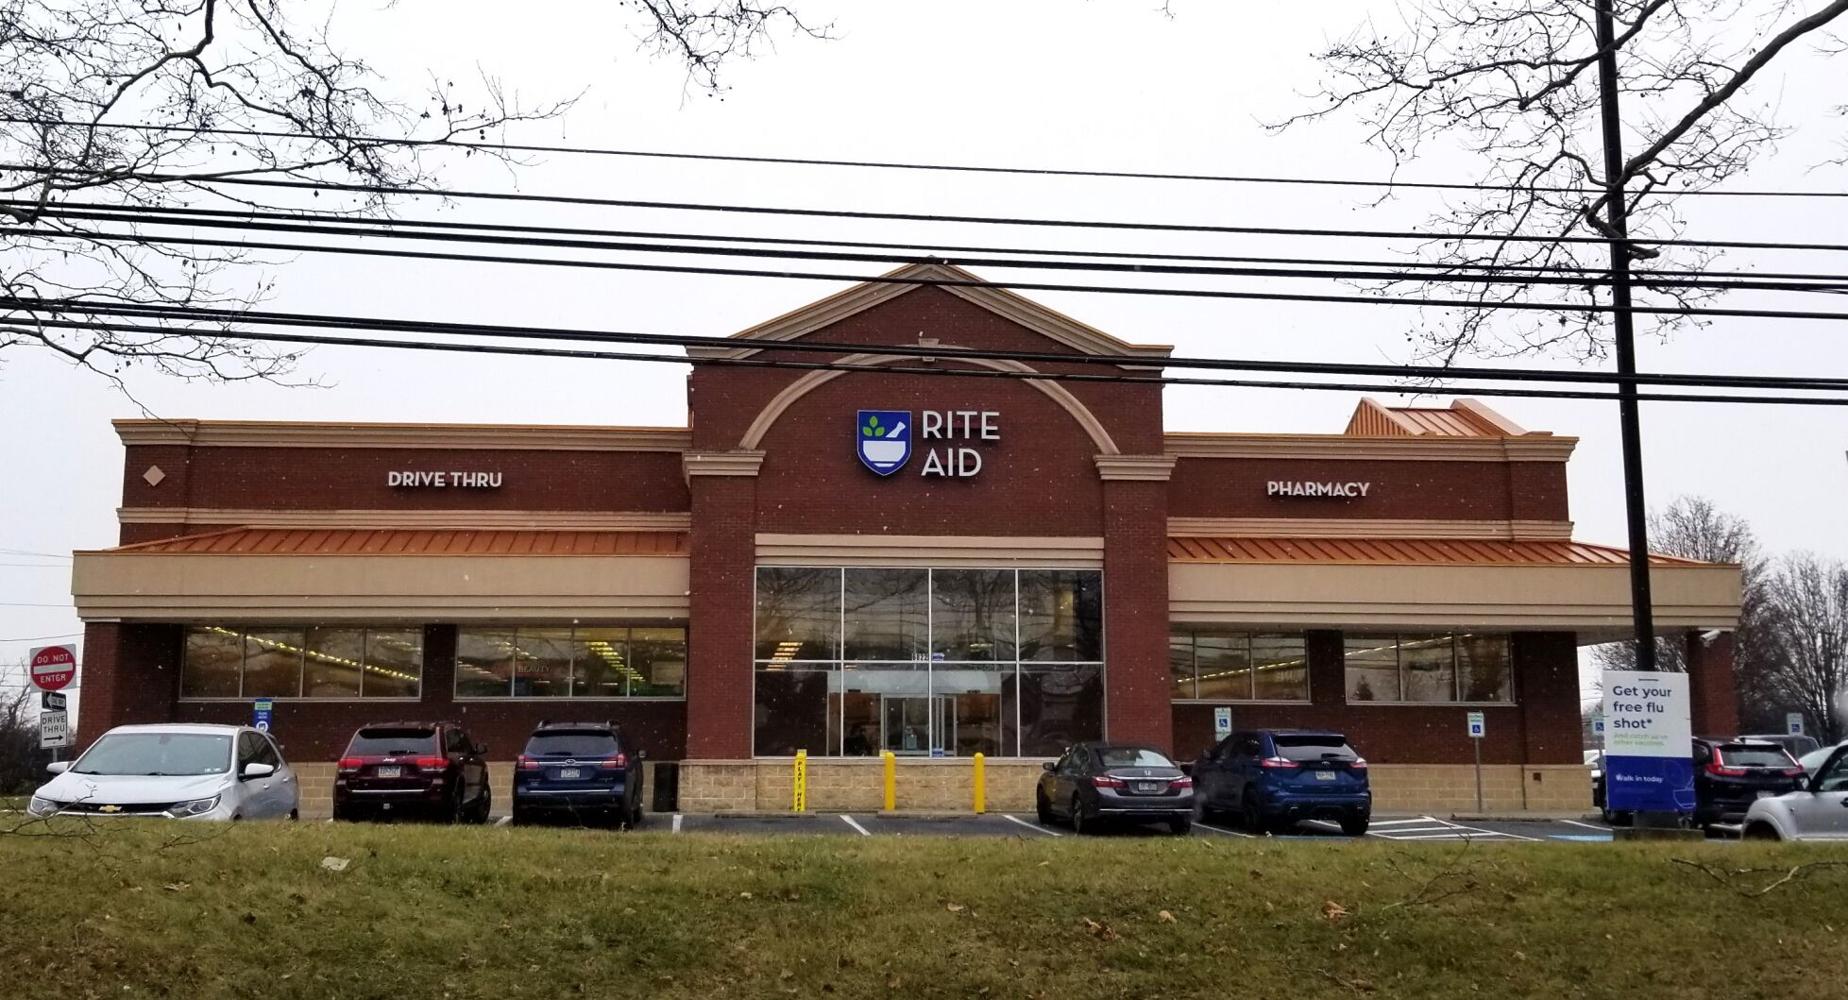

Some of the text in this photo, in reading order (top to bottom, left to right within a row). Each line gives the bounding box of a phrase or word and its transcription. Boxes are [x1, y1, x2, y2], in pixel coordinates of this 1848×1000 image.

[922, 410, 1000, 440] RITE
[921, 447, 982, 477] AID
[388, 471, 502, 487] DRIVE THRU
[1267, 481, 1370, 496] PHARMACY
[37, 653, 69, 664] DO NOT
[40, 674, 66, 684] ENTER
[1612, 685, 1672, 699] Get your
[1613, 700, 1665, 713] free flu
[42, 715, 65, 725] DRIVE
[43, 725, 65, 734] THRU
[1615, 774, 1634, 782] Walk
